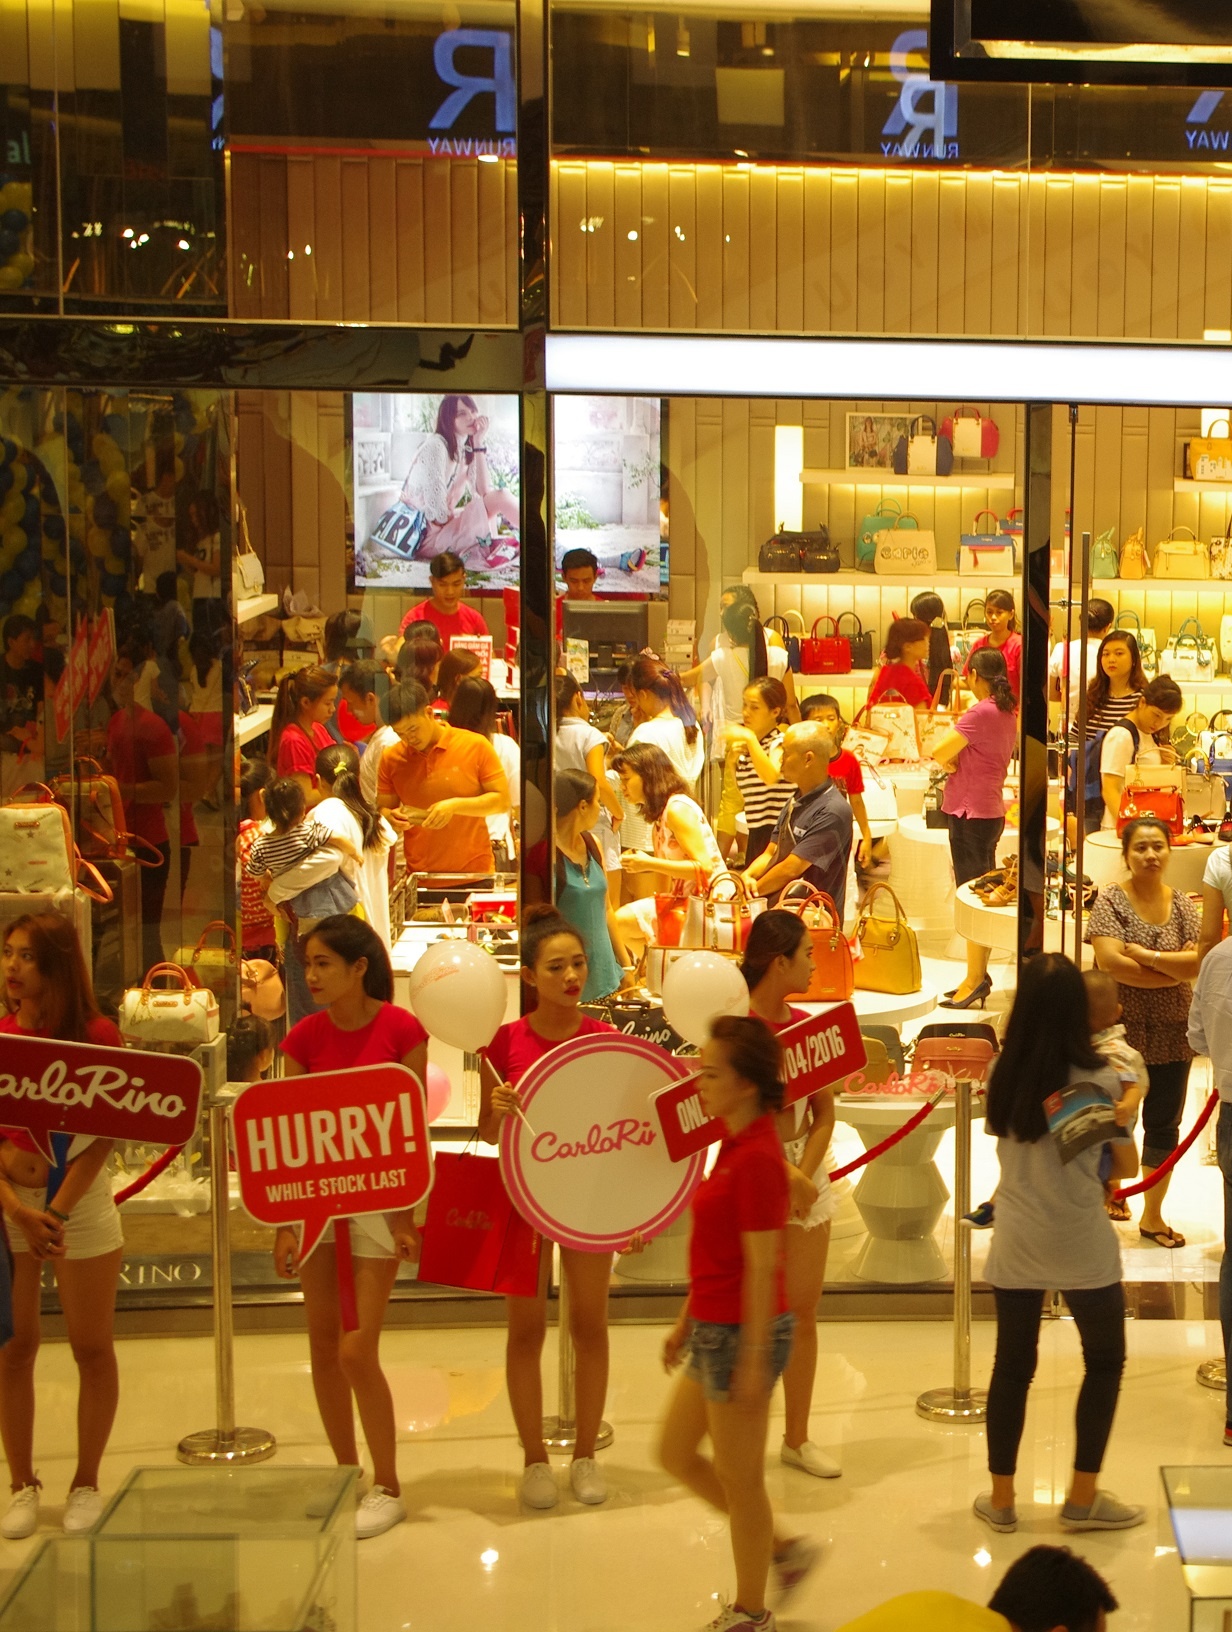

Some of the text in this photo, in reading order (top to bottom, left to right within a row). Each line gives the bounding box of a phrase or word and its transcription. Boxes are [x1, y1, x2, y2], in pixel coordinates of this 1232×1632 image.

[245, 1093, 417, 1173] HURRY!
[676, 1090, 716, 1134] ONL
[265, 1169, 407, 1204] WHILE STOCK LAST
